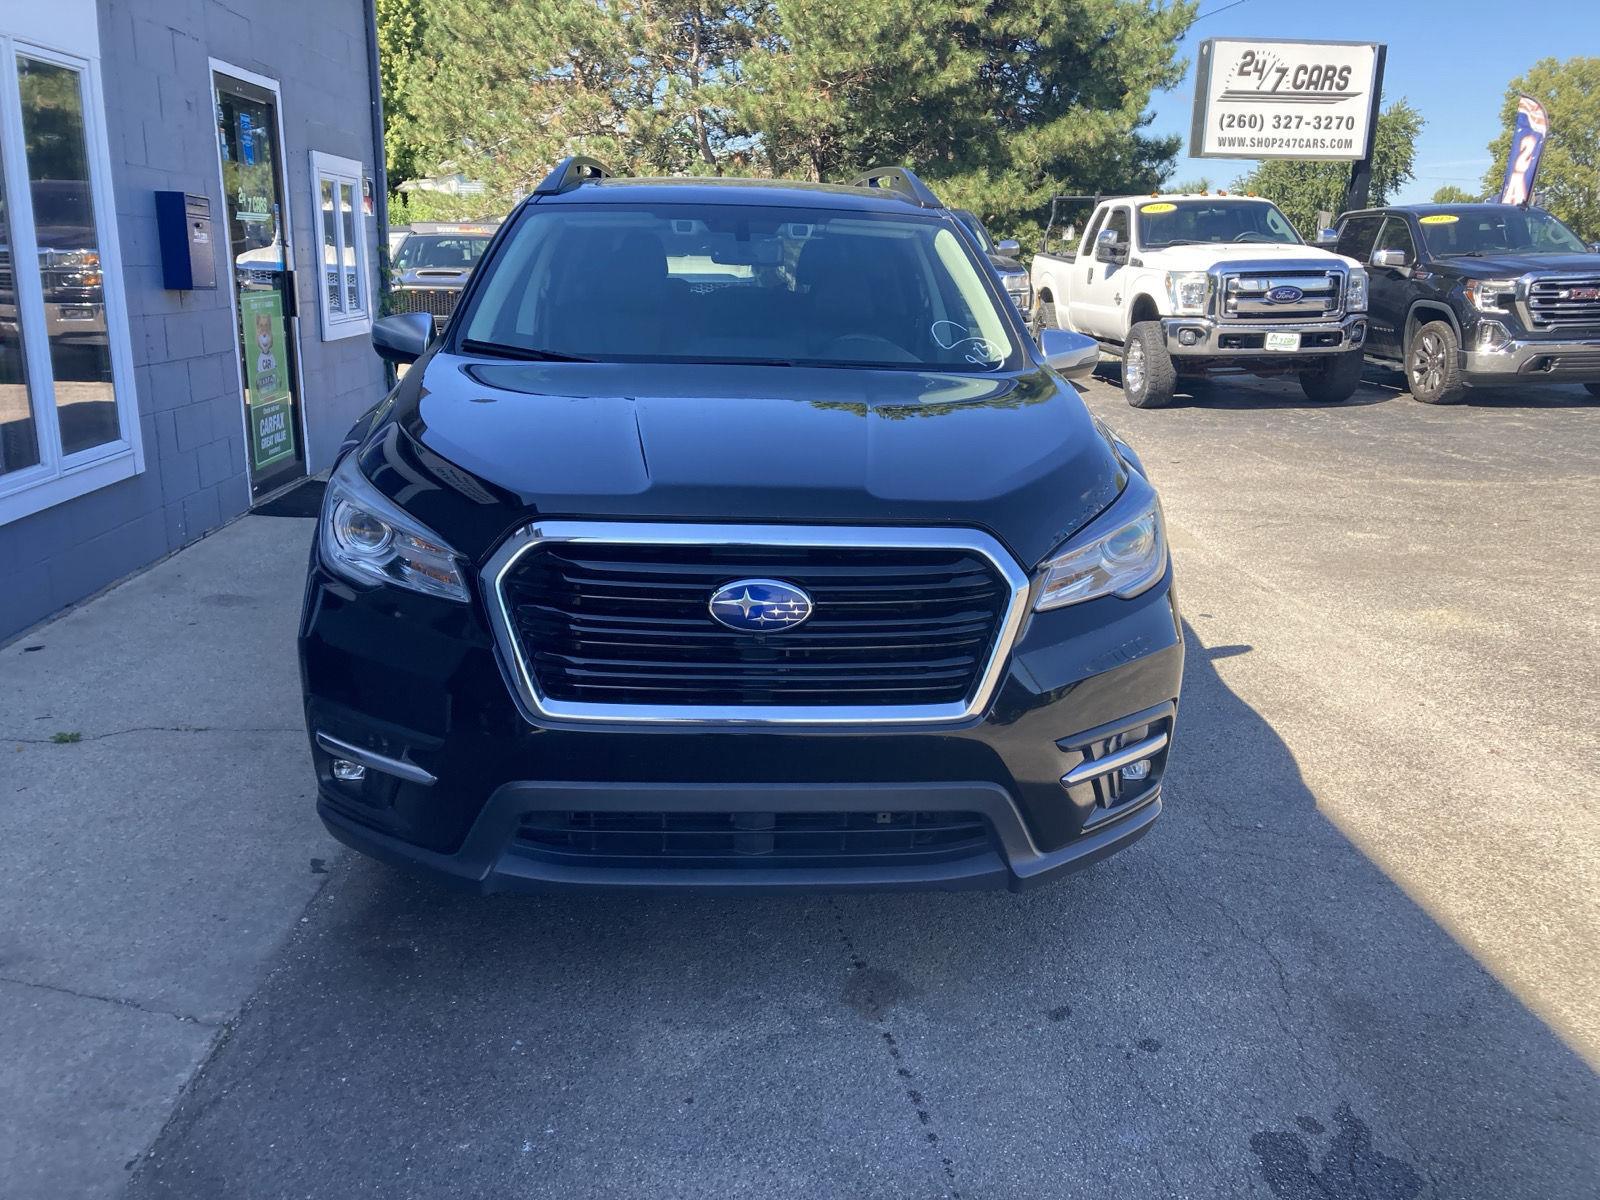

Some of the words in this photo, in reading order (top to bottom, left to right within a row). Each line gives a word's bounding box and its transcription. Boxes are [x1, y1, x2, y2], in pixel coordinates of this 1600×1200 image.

[1291, 64, 1352, 91] CARS
[1218, 113, 1264, 132] (260)
[1271, 115, 1355, 130] 327-3270
[1217, 136, 1353, 149] WWW.SHOP247CARS.COM
[1274, 290, 1297, 299] Ford
[261, 358, 273, 370] CAR
[259, 412, 285, 437] CARFAX
